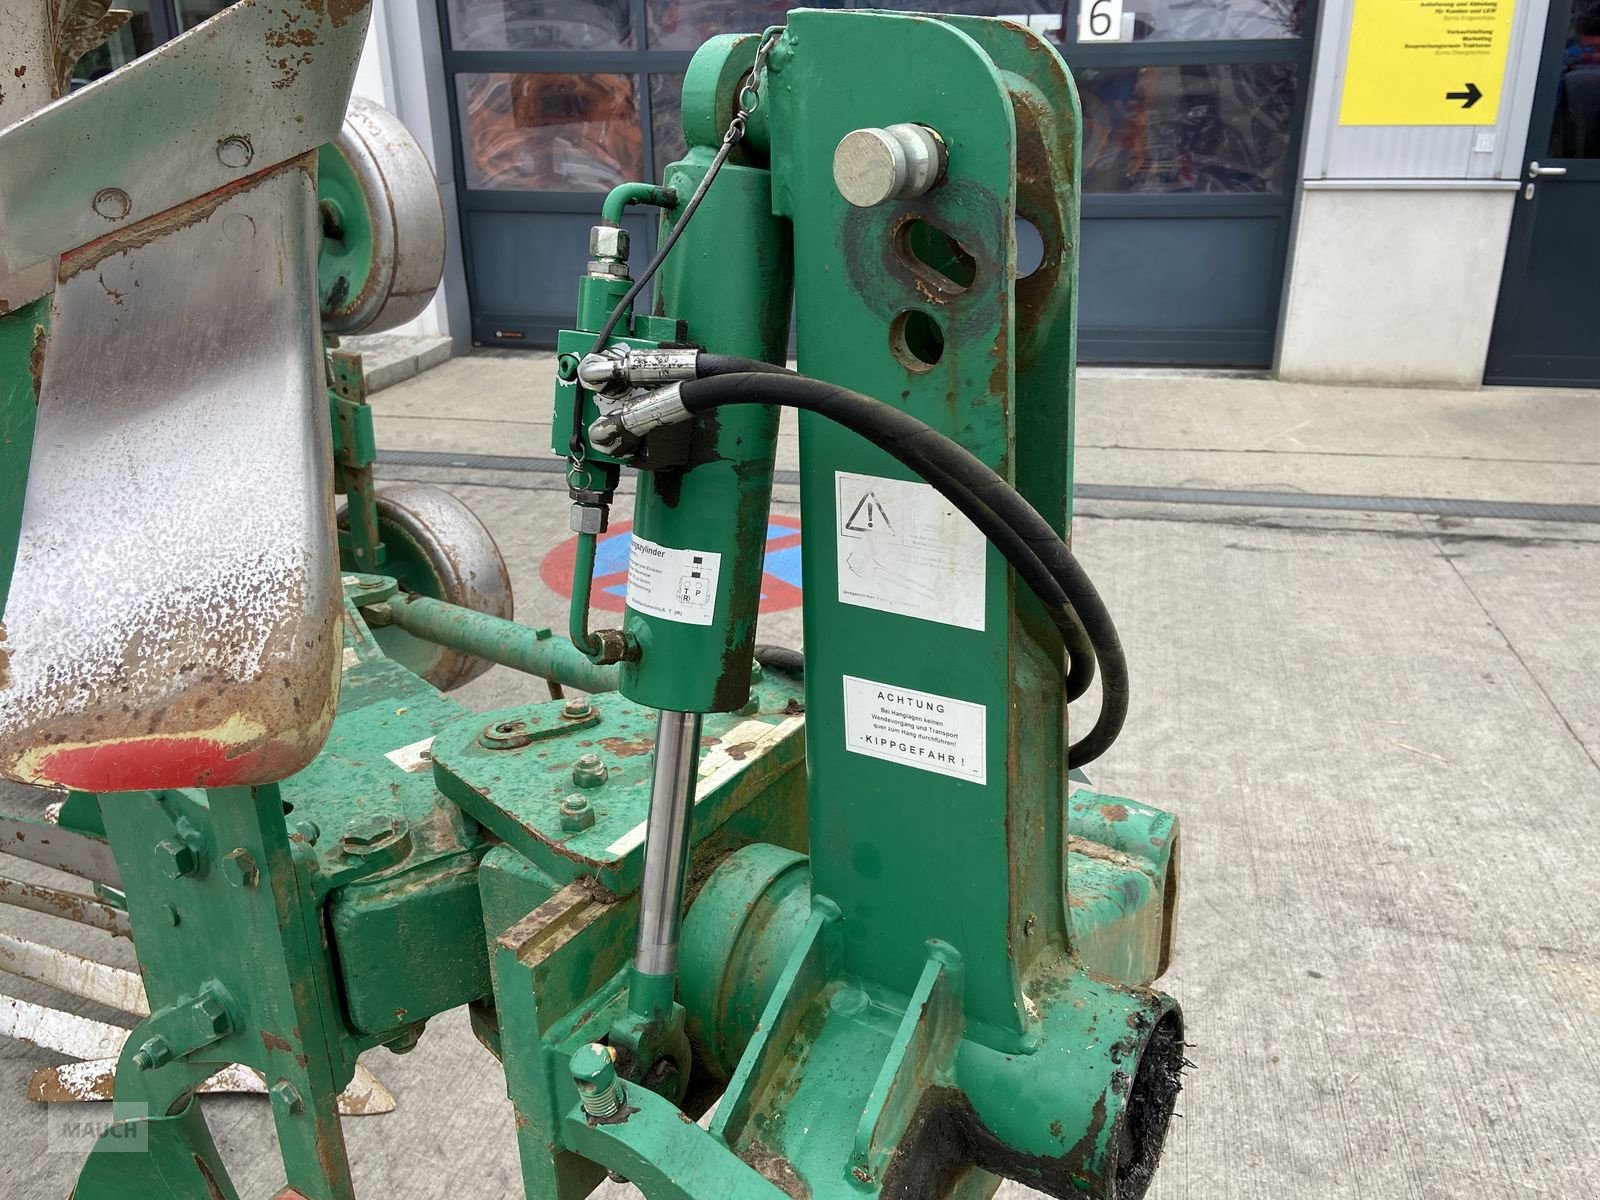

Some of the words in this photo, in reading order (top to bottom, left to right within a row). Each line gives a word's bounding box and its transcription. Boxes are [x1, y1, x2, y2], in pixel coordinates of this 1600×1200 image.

[1089, 0, 1112, 36] 6
[877, 691, 945, 713] ACHTUNG
[871, 713, 915, 730] Wendevorgang
[916, 724, 928, 732] und
[929, 727, 959, 739] Transport
[891, 709, 923, 722] Hanglagen
[924, 716, 944, 726] keinen
[873, 723, 887, 731] quer
[901, 729, 917, 739] Hang
